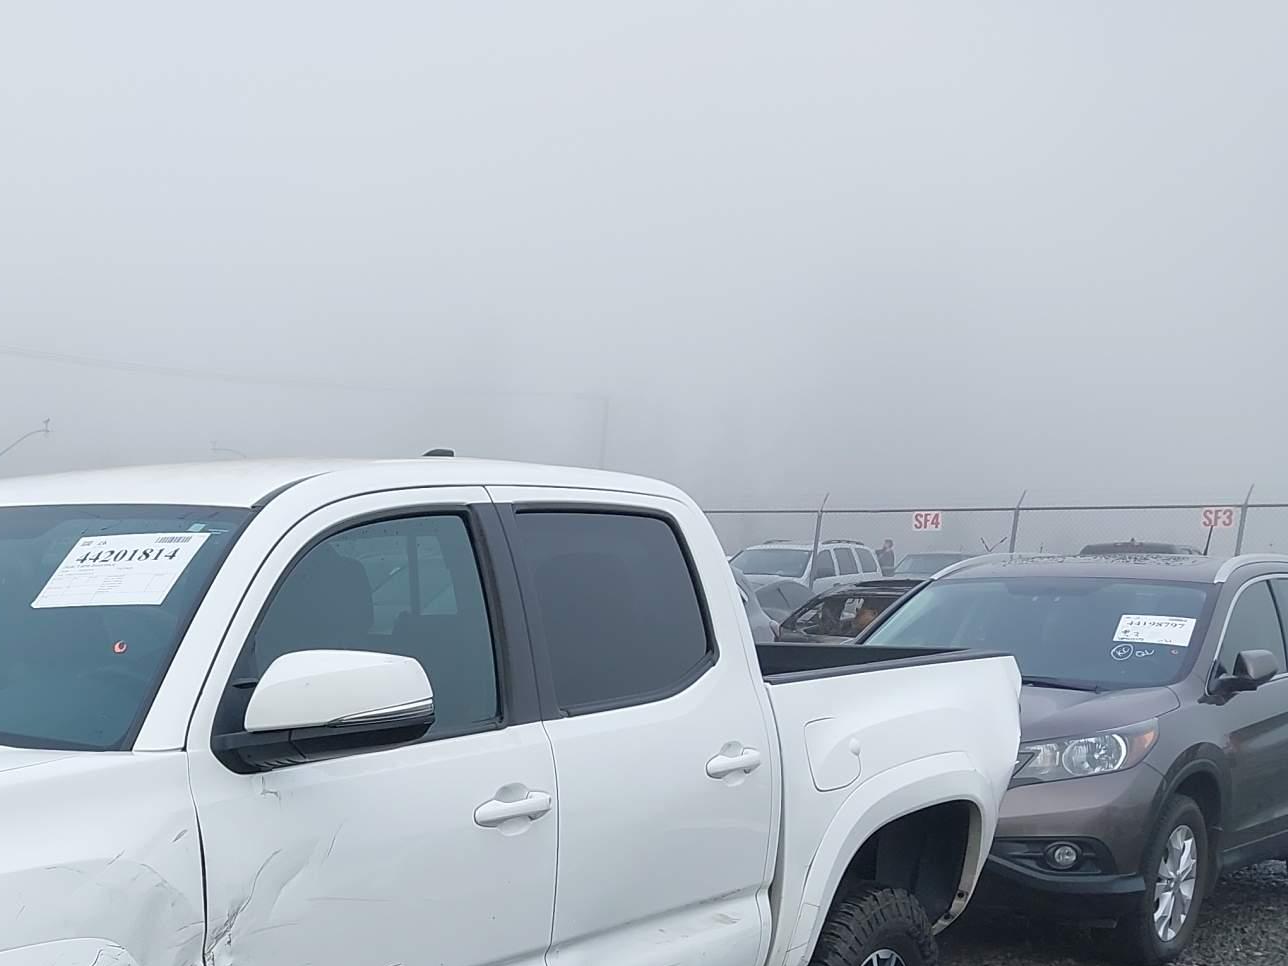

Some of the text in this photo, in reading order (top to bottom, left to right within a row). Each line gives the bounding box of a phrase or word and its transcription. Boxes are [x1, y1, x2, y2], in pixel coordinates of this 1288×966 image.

[914, 513, 940, 529] SF4
[1202, 509, 1233, 527] SF3
[75, 547, 181, 564] 44201814
